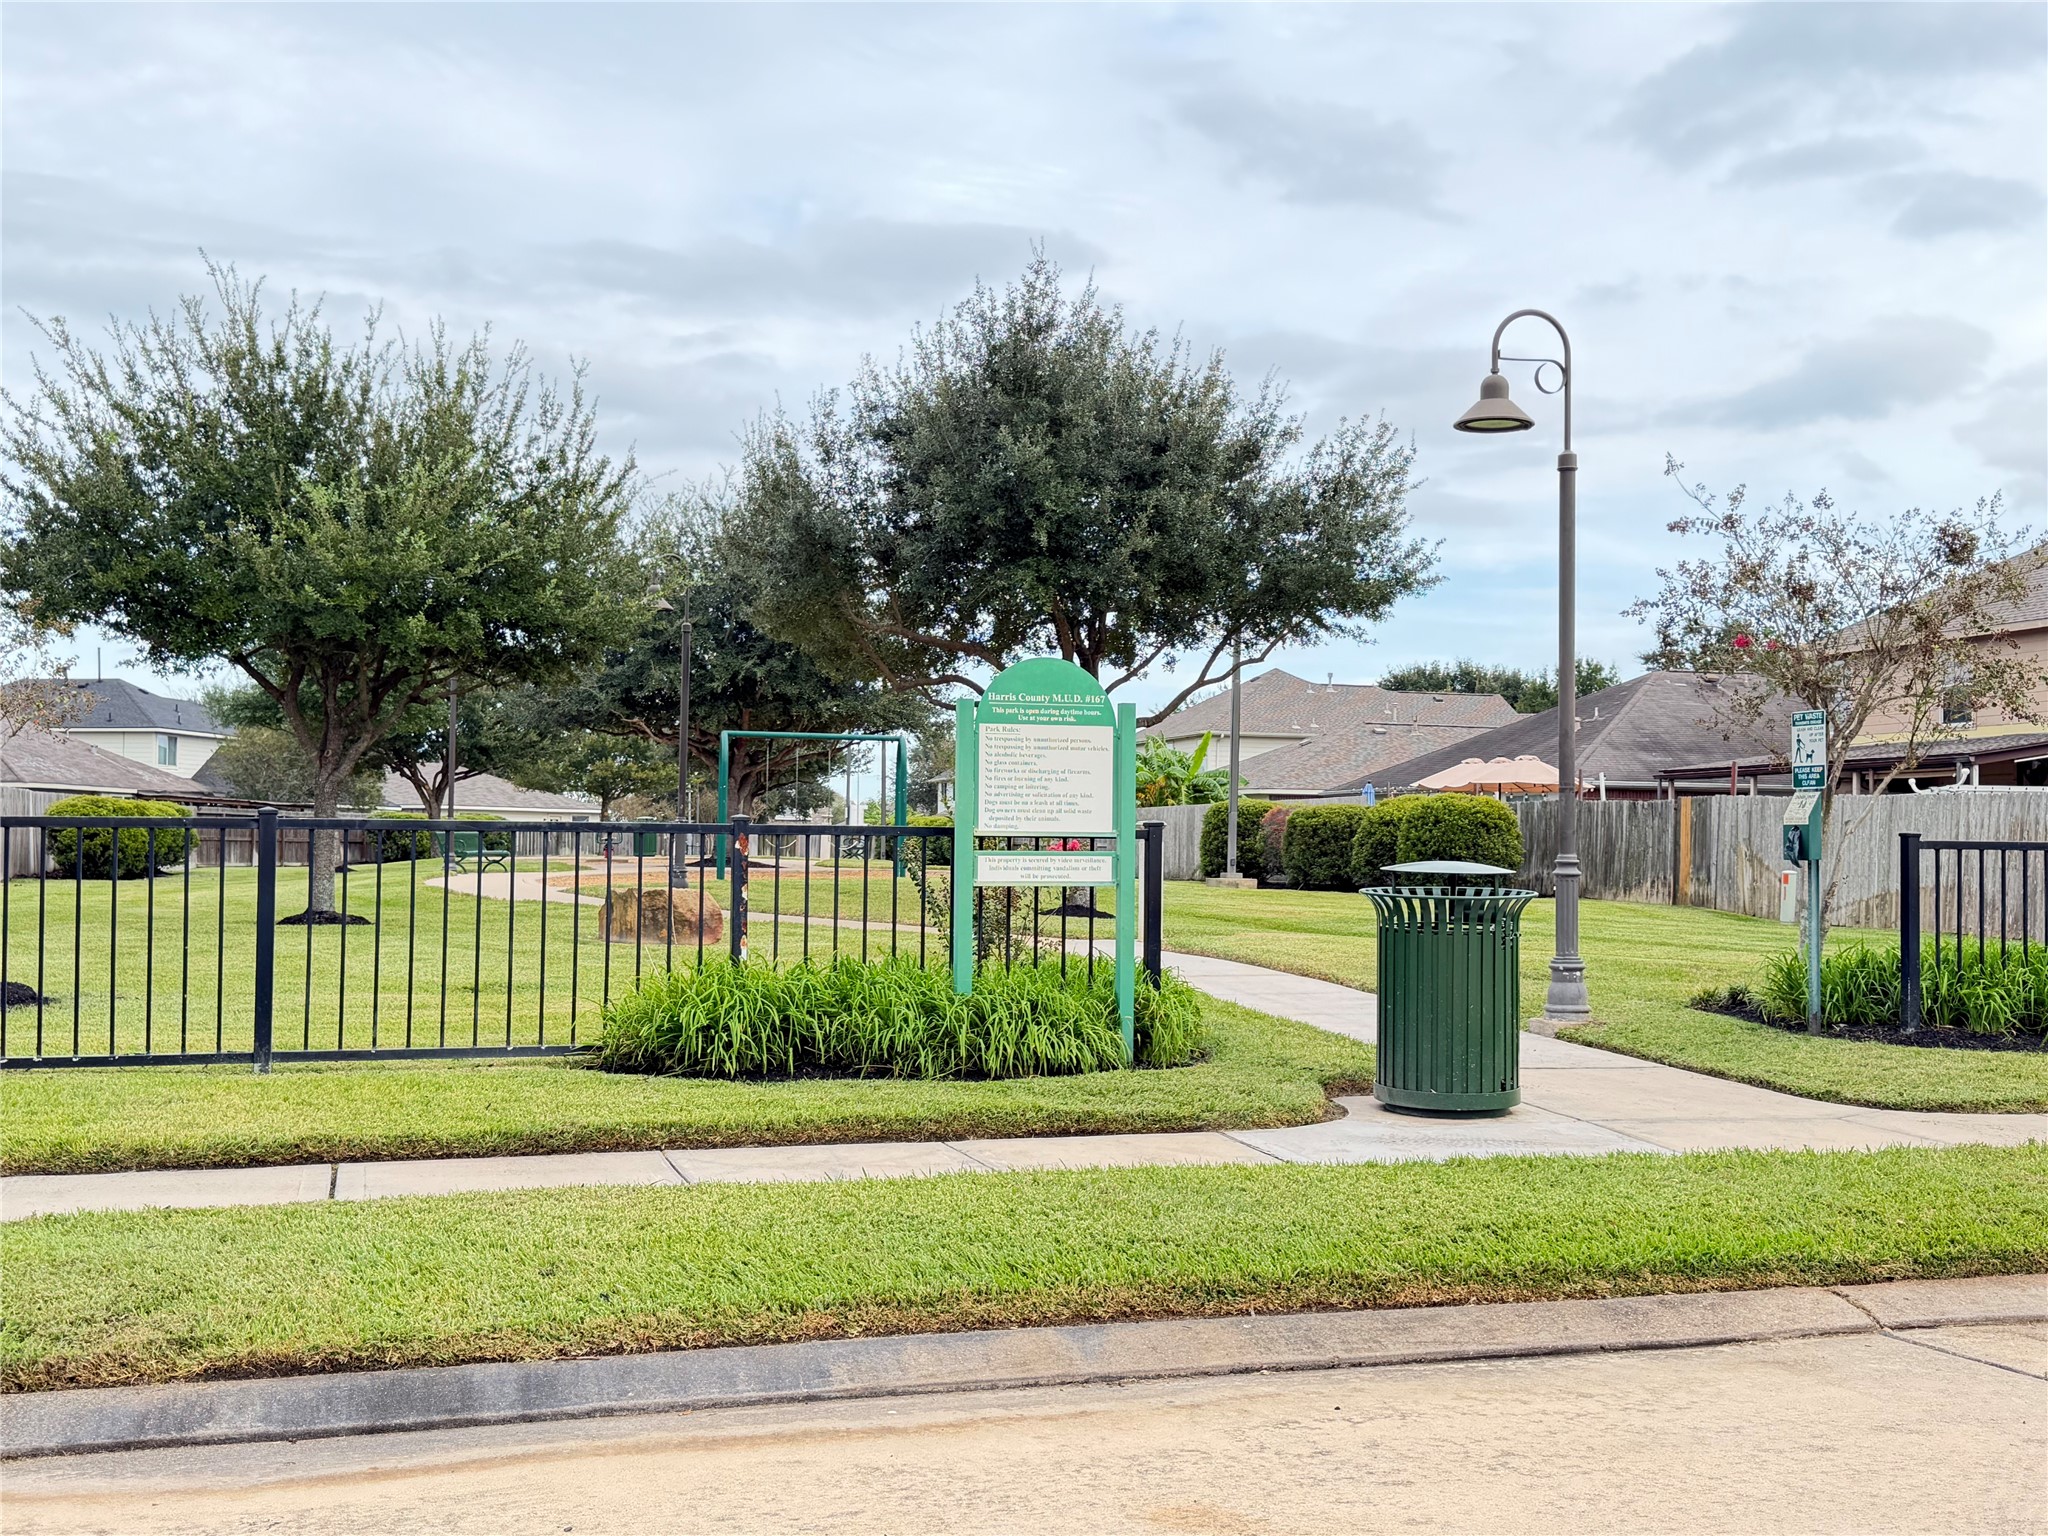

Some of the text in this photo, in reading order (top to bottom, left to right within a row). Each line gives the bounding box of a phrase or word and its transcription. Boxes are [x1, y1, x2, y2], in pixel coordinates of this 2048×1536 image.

[988, 692, 1105, 704] Harris County M.U.D. #167
[1060, 709, 1083, 717] daytime
[1805, 712, 1823, 720] WASTE
